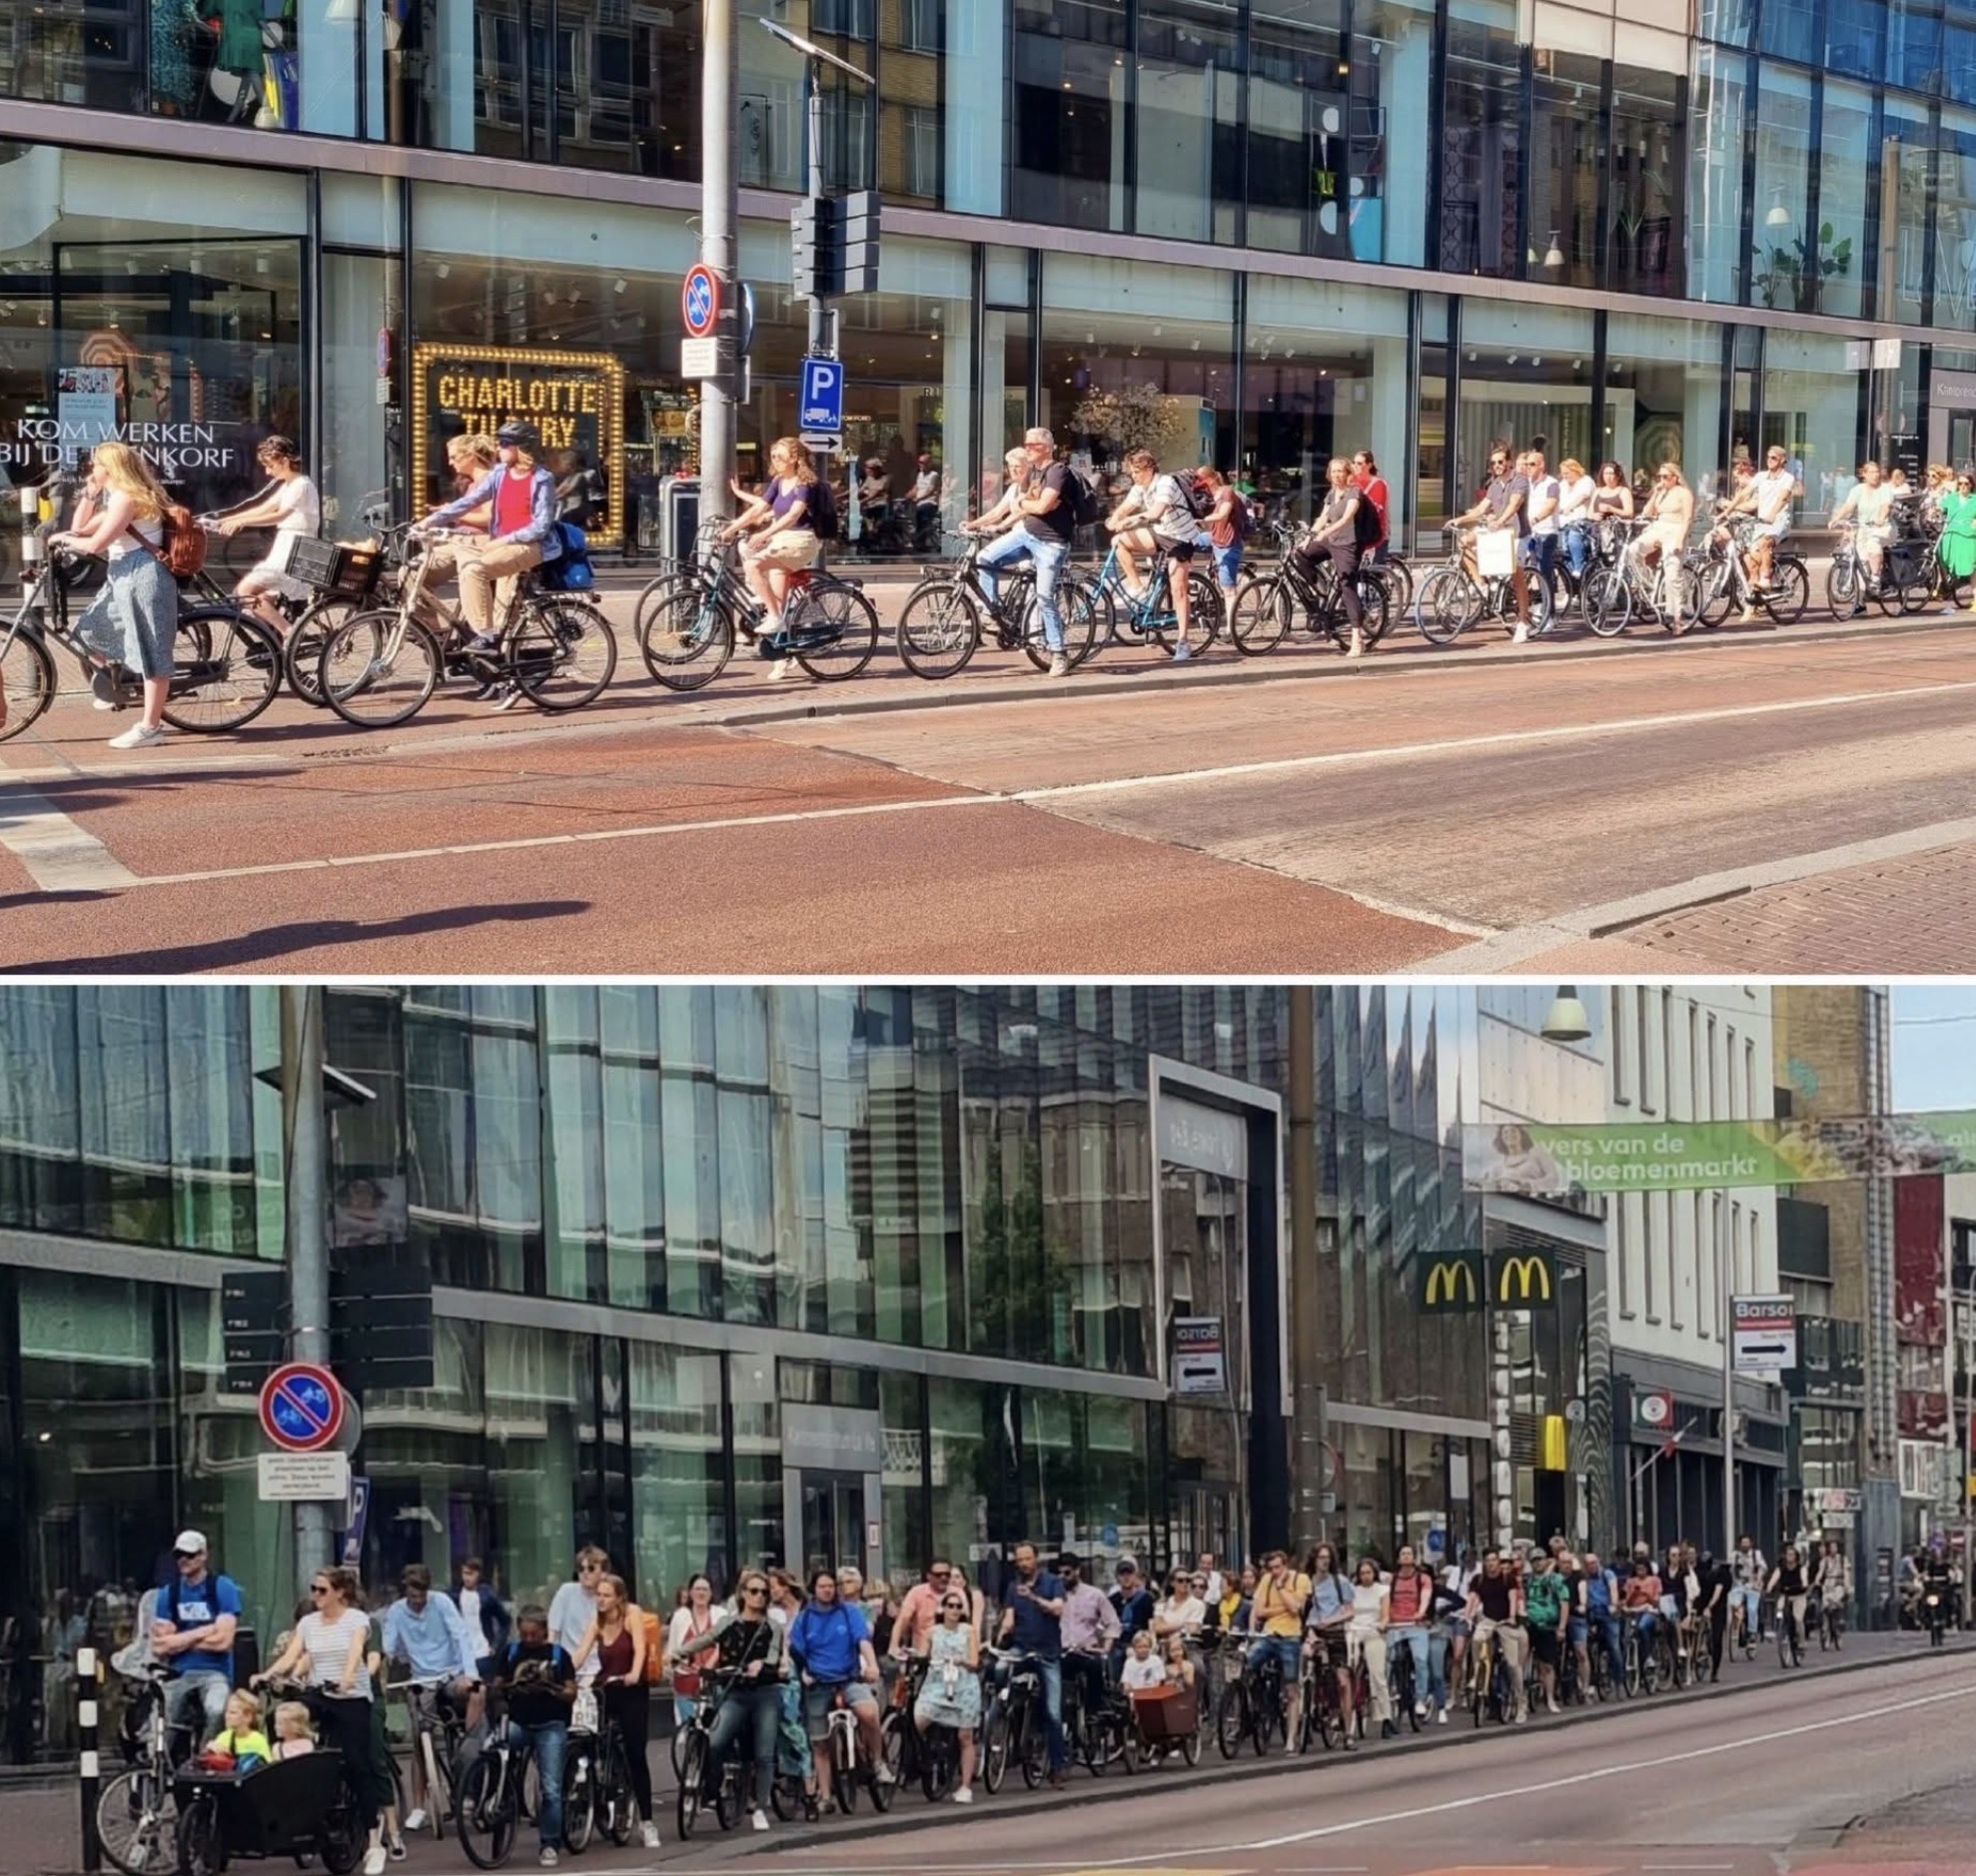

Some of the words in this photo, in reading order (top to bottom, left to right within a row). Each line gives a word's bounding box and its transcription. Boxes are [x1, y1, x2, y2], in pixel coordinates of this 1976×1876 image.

[439, 375, 597, 414] CHARLOTTE
[812, 367, 834, 400] P
[18, 419, 88, 440] KOM
[98, 422, 214, 444] WERKEN
[42, 444, 78, 464] DE
[1541, 1138, 1593, 1156] vers
[1598, 1138, 1648, 1154] van
[1652, 1133, 1684, 1154] de
[1566, 1155, 1758, 1182] bloemenmarkt
